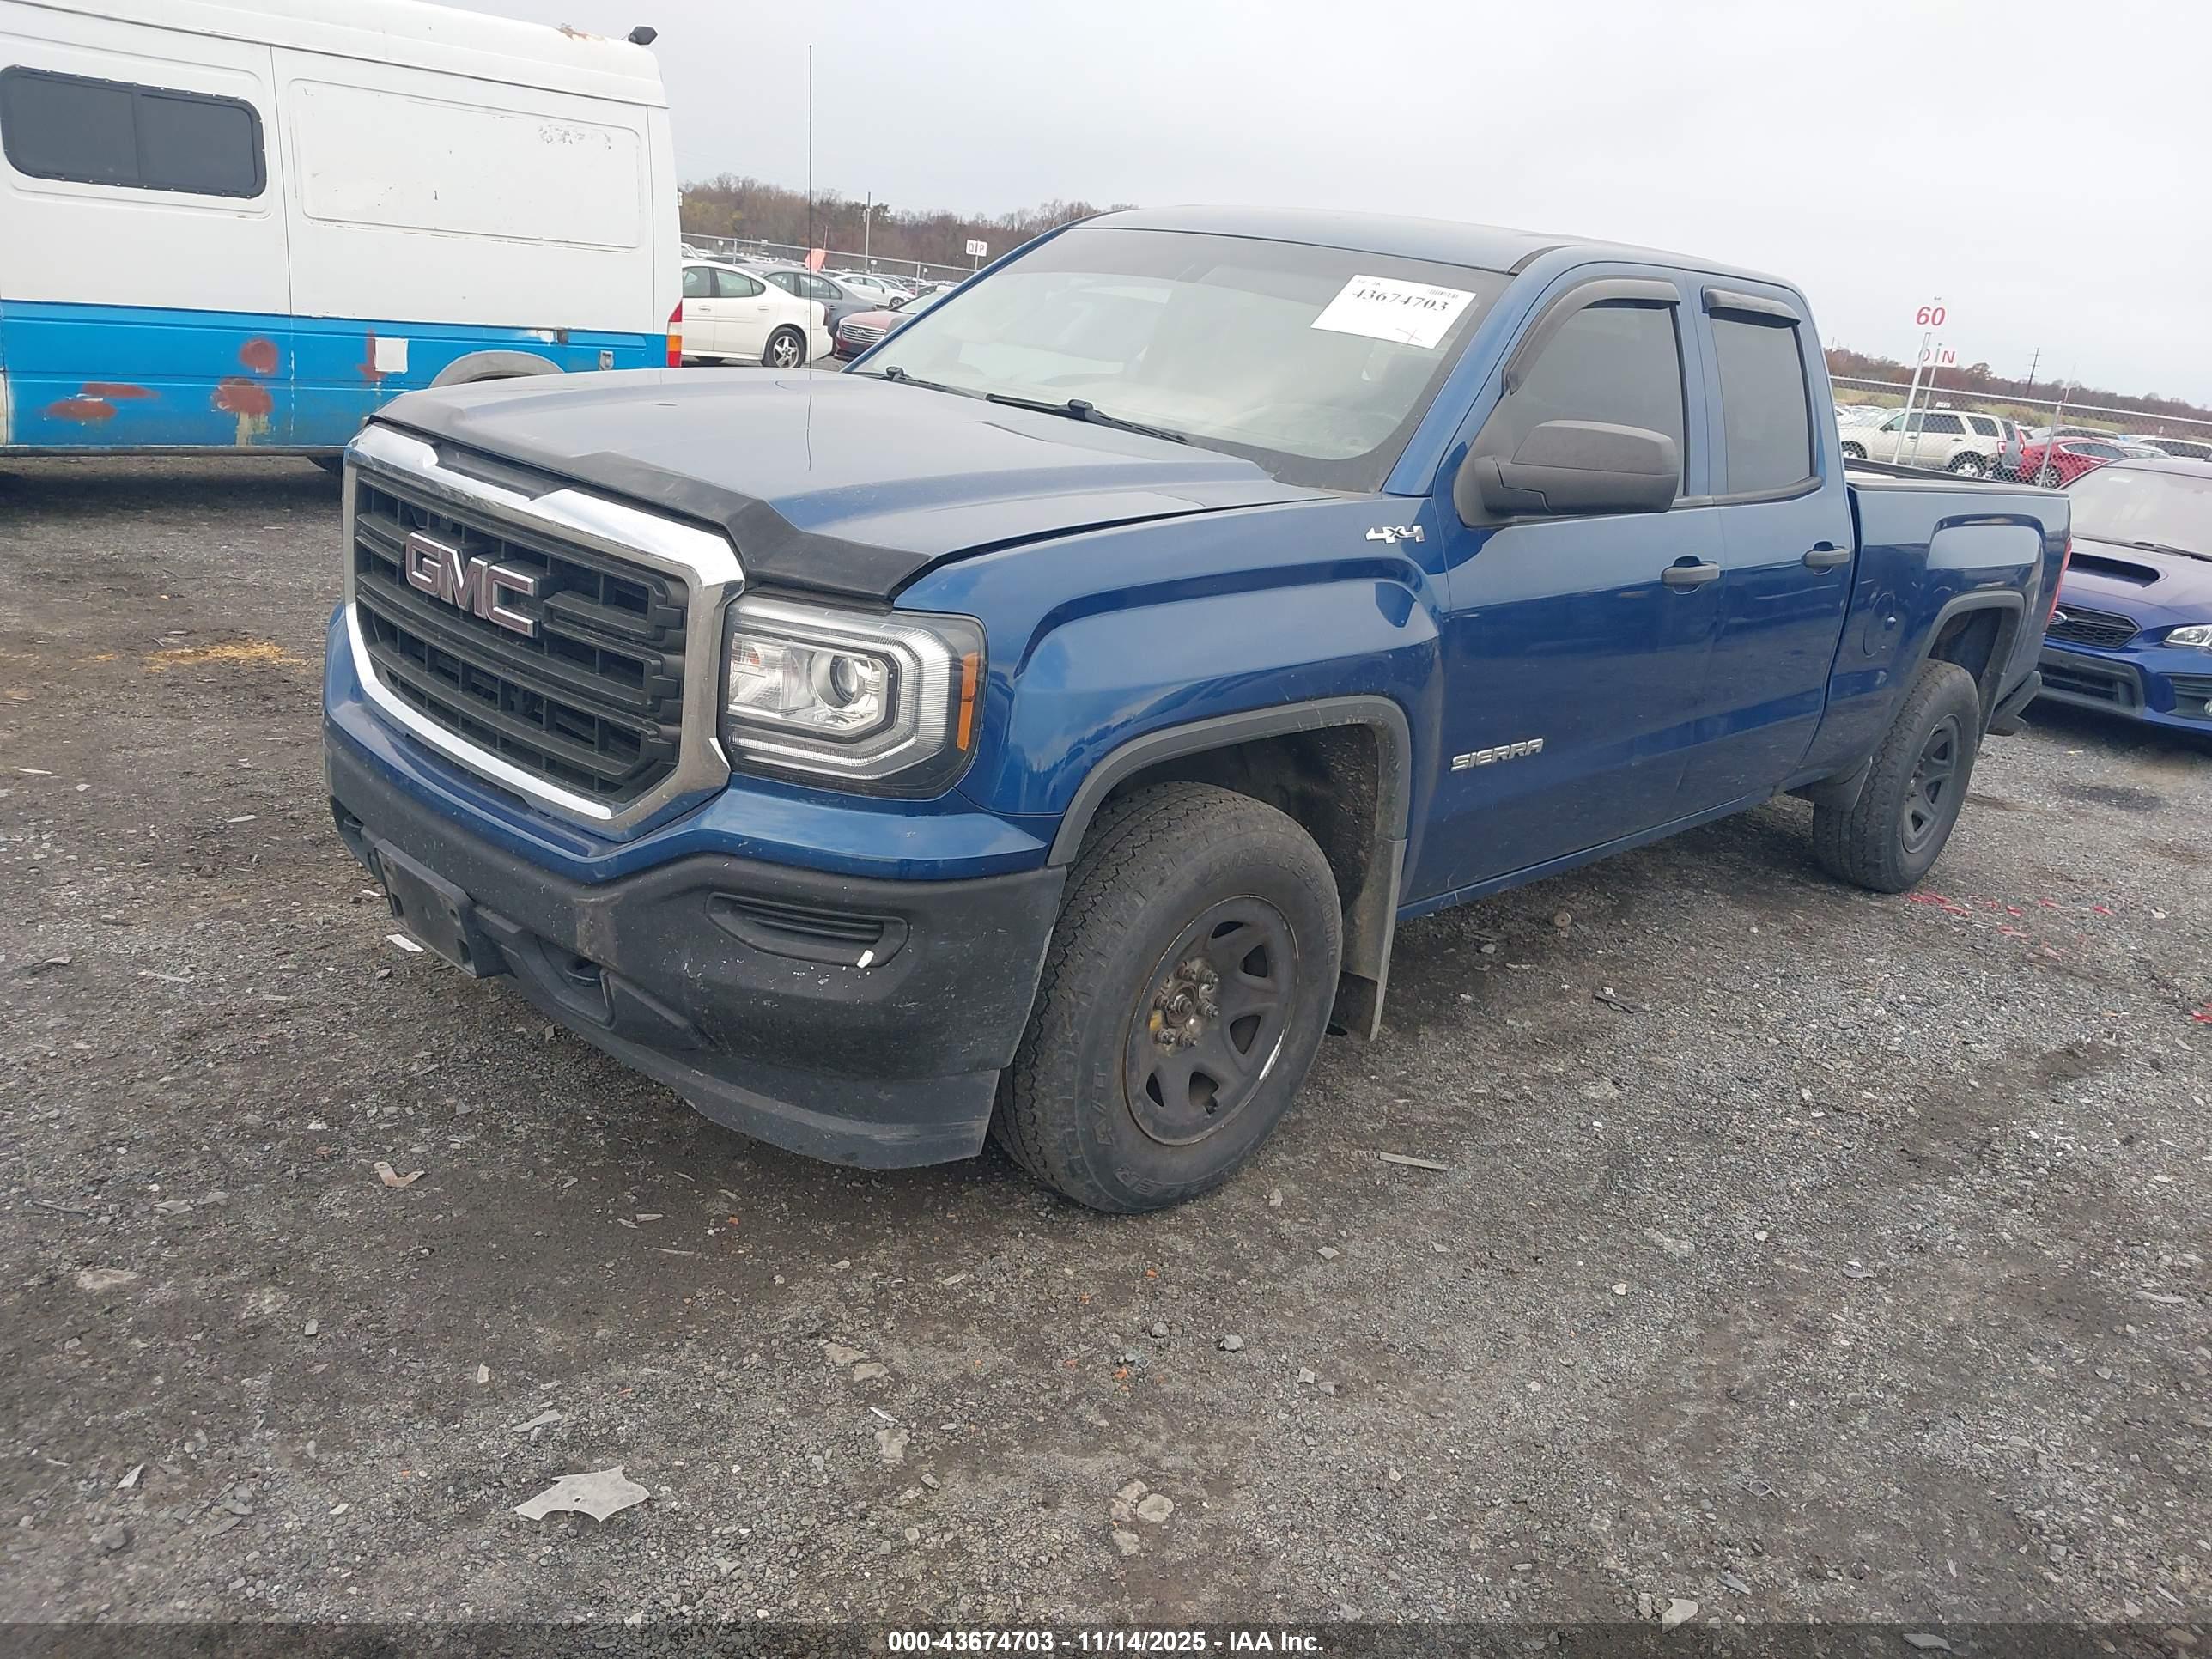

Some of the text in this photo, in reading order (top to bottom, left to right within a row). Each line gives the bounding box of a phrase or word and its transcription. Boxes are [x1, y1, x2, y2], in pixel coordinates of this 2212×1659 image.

[1352, 289, 1449, 311] 43674703
[1916, 306, 1946, 326] 60
[405, 532, 538, 639] GMC
[1449, 737, 1545, 772] SIERRA
